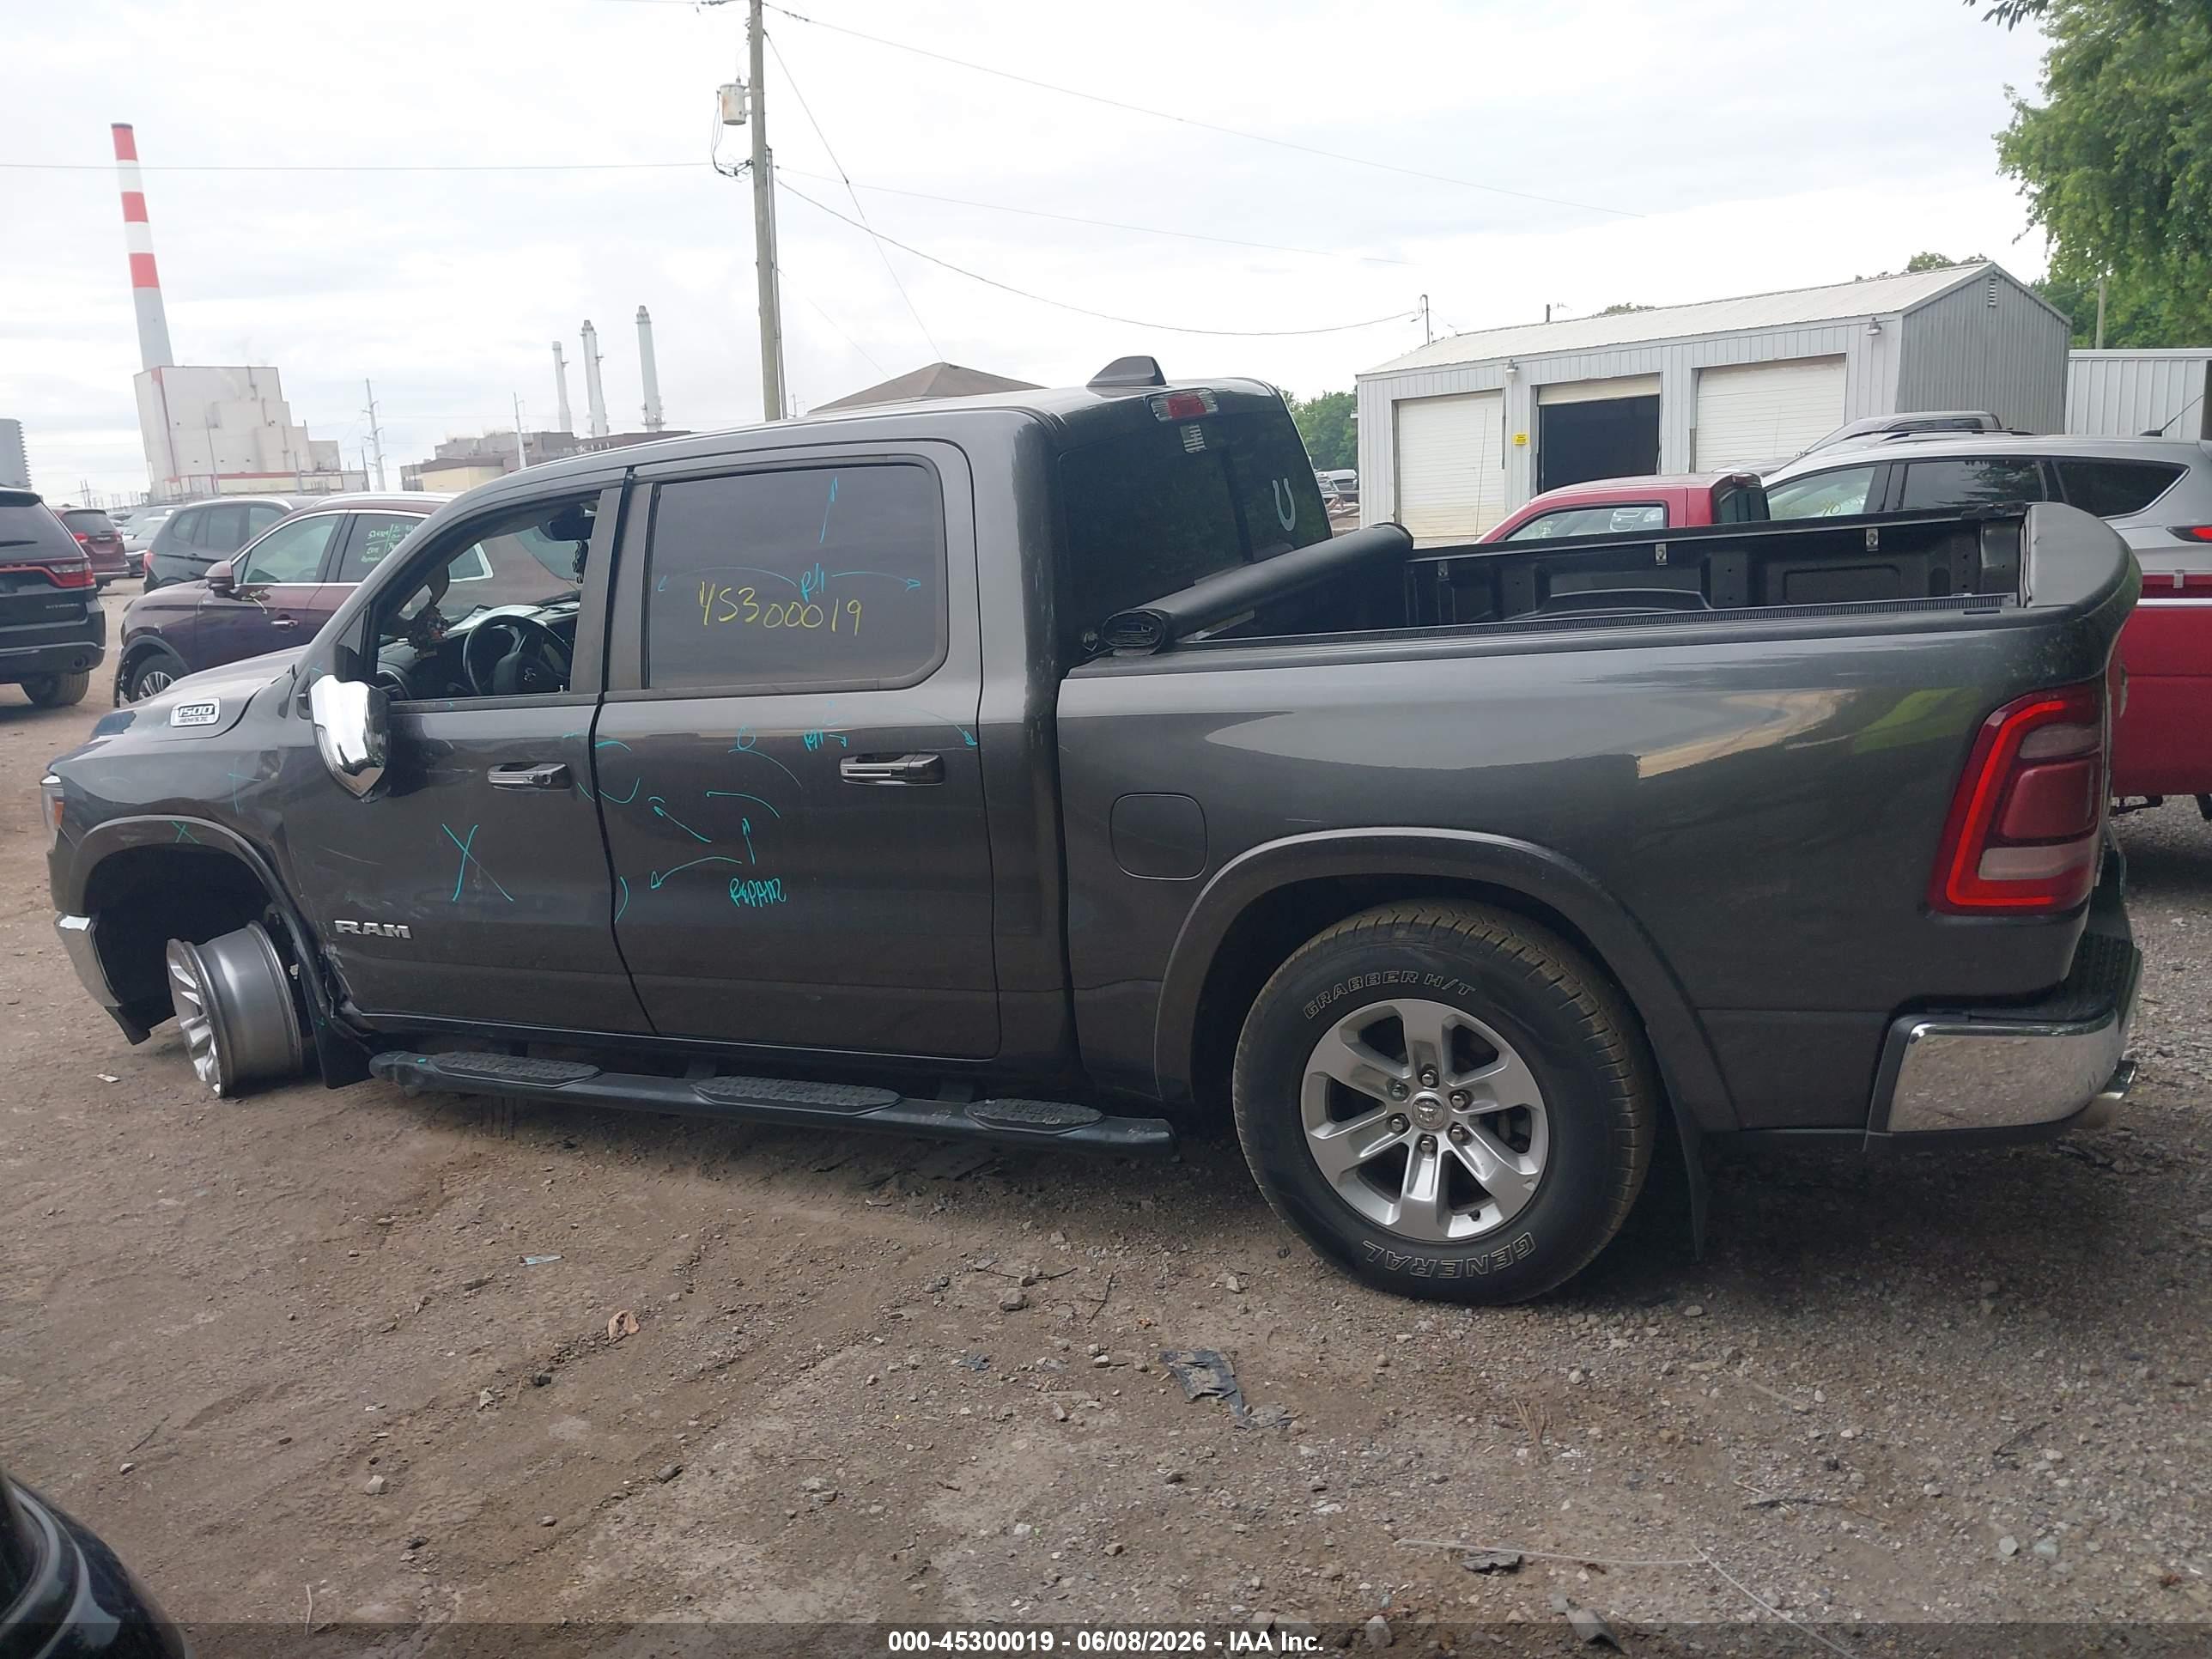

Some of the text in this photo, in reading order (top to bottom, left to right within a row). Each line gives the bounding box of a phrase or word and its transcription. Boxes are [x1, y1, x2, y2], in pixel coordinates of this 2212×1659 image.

[698, 580, 862, 635] 45300019
[179, 705, 214, 717] 1500
[334, 920, 412, 939] RAM
[1304, 970, 1476, 1020] GRABBER H/T
[1362, 1231, 1537, 1279] GENERAL
